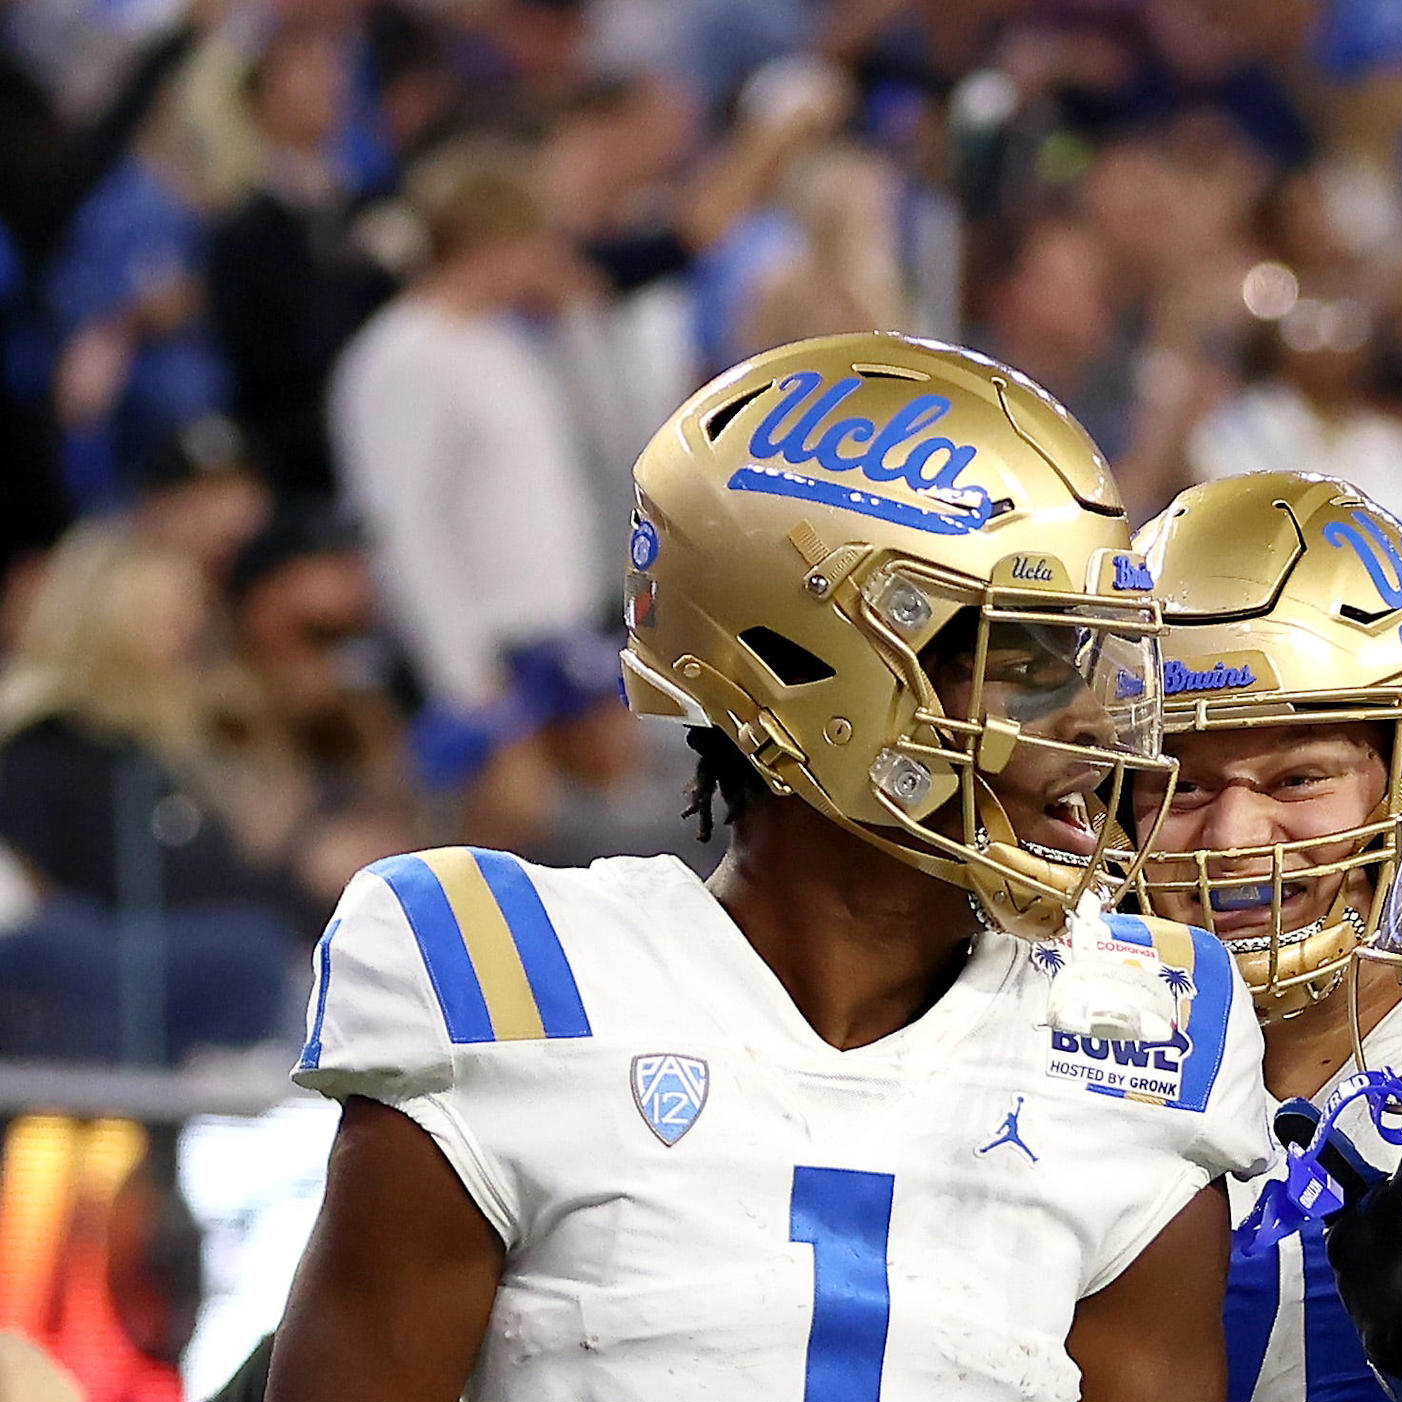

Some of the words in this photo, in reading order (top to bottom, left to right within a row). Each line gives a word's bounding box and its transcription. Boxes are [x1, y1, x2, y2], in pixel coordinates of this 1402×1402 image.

[749, 371, 982, 492] Ucla
[1011, 556, 1053, 582] Ucla
[1162, 660, 1257, 696] Bruins
[1049, 1059, 1105, 1083] HOSTED
[1107, 1071, 1126, 1086] BY
[1129, 1076, 1178, 1097] GRONK
[651, 1091, 690, 1125] 12
